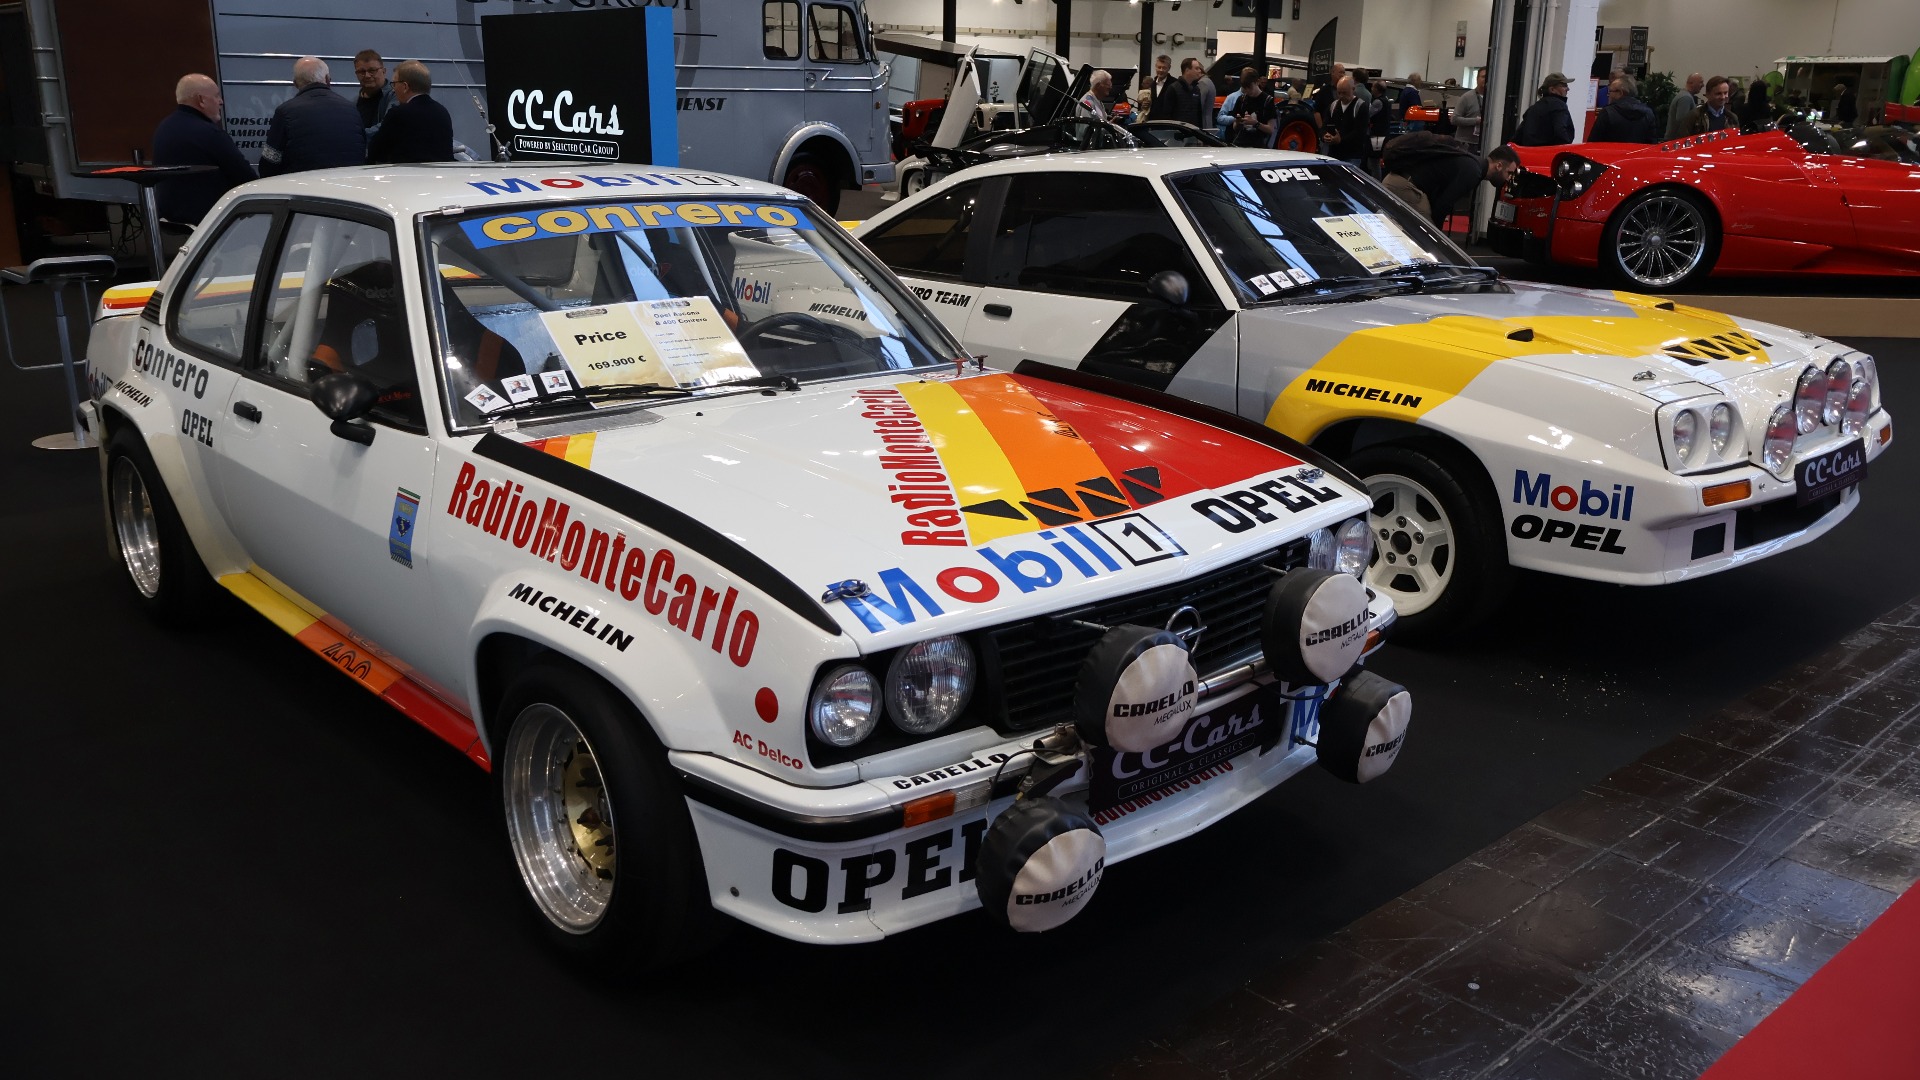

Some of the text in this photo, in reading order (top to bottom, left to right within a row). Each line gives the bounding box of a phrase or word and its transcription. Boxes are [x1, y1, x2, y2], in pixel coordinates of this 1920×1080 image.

[507, 89, 624, 135] CC-Cars
[519, 139, 543, 150] POWERED
[552, 141, 578, 152] SELECTED
[579, 143, 592, 154] CAR
[593, 145, 614, 155] GROUP
[466, 173, 683, 196] Mobil
[1260, 167, 1320, 184] OPEL
[482, 203, 798, 242] conrero
[1336, 231, 1361, 239] Price
[734, 276, 771, 304] Mobil
[935, 290, 971, 308] TEAM
[808, 303, 868, 321] MICHELIN
[574, 331, 628, 345] Price
[135, 339, 209, 400] conrero
[588, 357, 635, 370] 169.900
[113, 380, 154, 408] MICHELIN
[1305, 379, 1422, 408] MICHELIN
[181, 408, 214, 447] OPEL
[851, 389, 968, 546] RadioMonteCarlo
[1804, 450, 1861, 487] CC-Cars
[1190, 475, 1343, 534] OPEL
[1513, 469, 1634, 521] Mobil
[1511, 514, 1627, 555] OPEL
[446, 461, 760, 667] RadioMonteCarlo
[826, 521, 1165, 634] Mobil 1
[507, 583, 635, 653] MICHELIN
[1305, 608, 1369, 647] CARELLO
[1114, 680, 1194, 718] CARELLO
[1154, 700, 1192, 726] MEGALUX
[733, 730, 803, 769] AC Delco
[1112, 704, 1264, 779] CC-Cars
[893, 753, 1010, 790] CARELLO
[1131, 741, 1243, 792] ORIGINAL & CLASSICS
[1016, 857, 1104, 906] CARELLO
